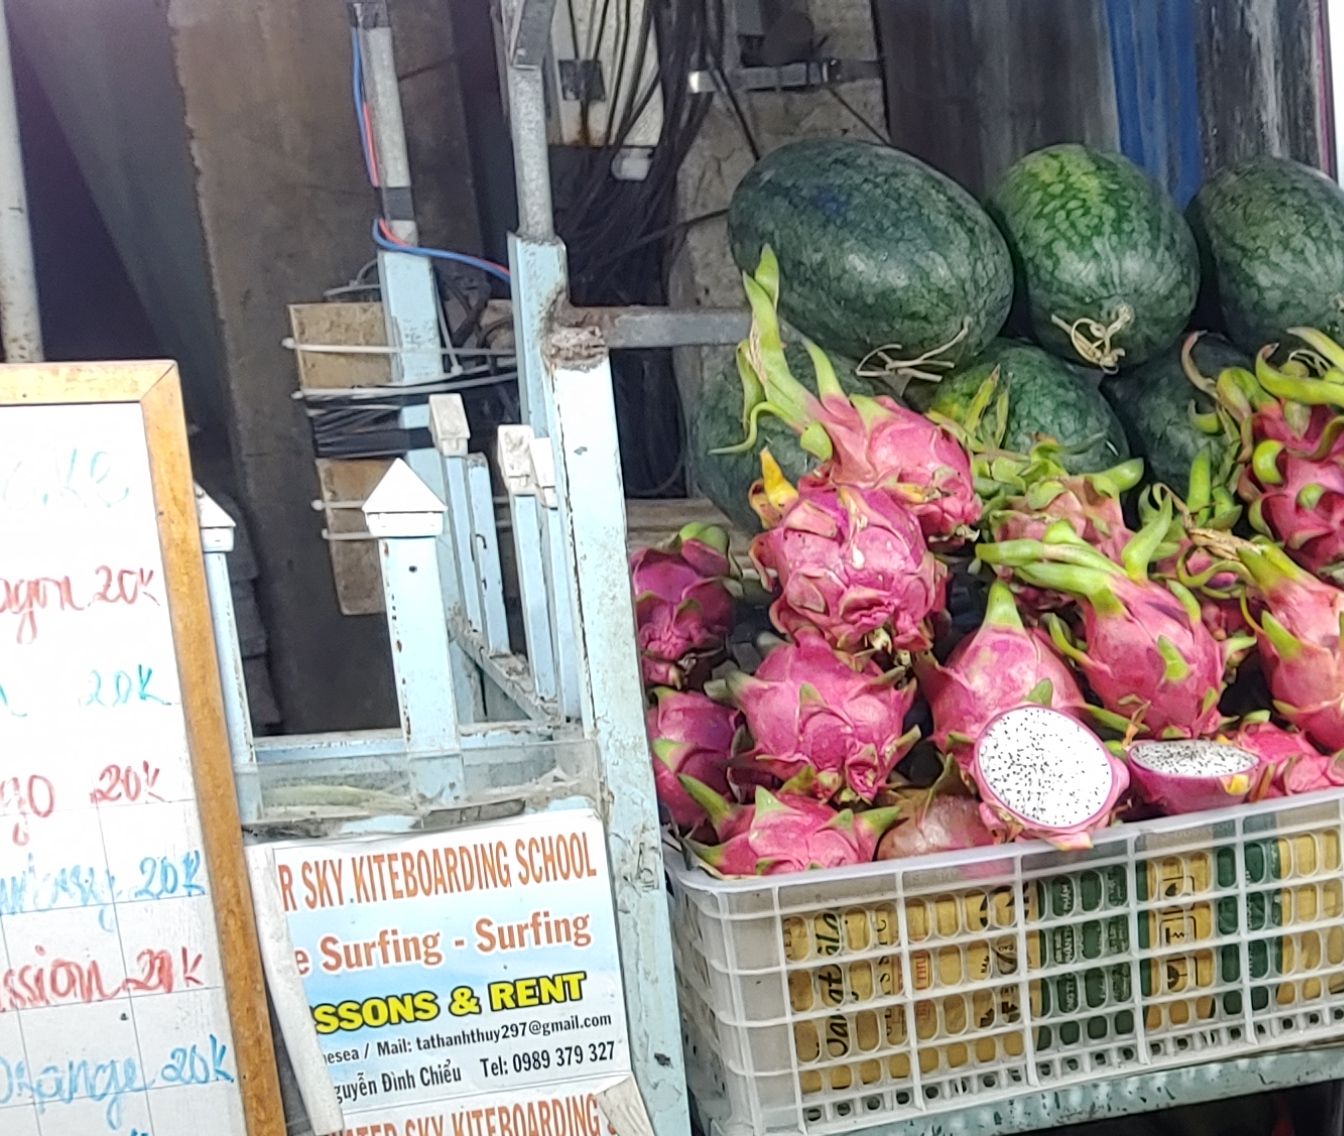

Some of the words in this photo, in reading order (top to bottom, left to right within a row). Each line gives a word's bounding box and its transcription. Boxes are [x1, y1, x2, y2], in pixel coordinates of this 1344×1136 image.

[301, 858, 343, 910] SKY
[353, 838, 512, 904] KITEBOARDING
[514, 831, 597, 886] SCHOOL
[320, 926, 443, 971] Surfing
[475, 911, 592, 954] Surfing
[310, 991, 439, 1034] SSONS
[449, 985, 480, 1017] &
[488, 971, 587, 1012] RENT
[376, 1039, 413, 1059] Mail:
[416, 1012, 613, 1053] tathanhthuy297@gmail.com
[381, 1068, 416, 1094] Đình
[419, 1058, 462, 1087] Chiểu
[479, 1056, 510, 1079] Tel:
[511, 1049, 553, 1075] 0989
[556, 1044, 584, 1069] 379
[587, 1040, 617, 1064] 327
